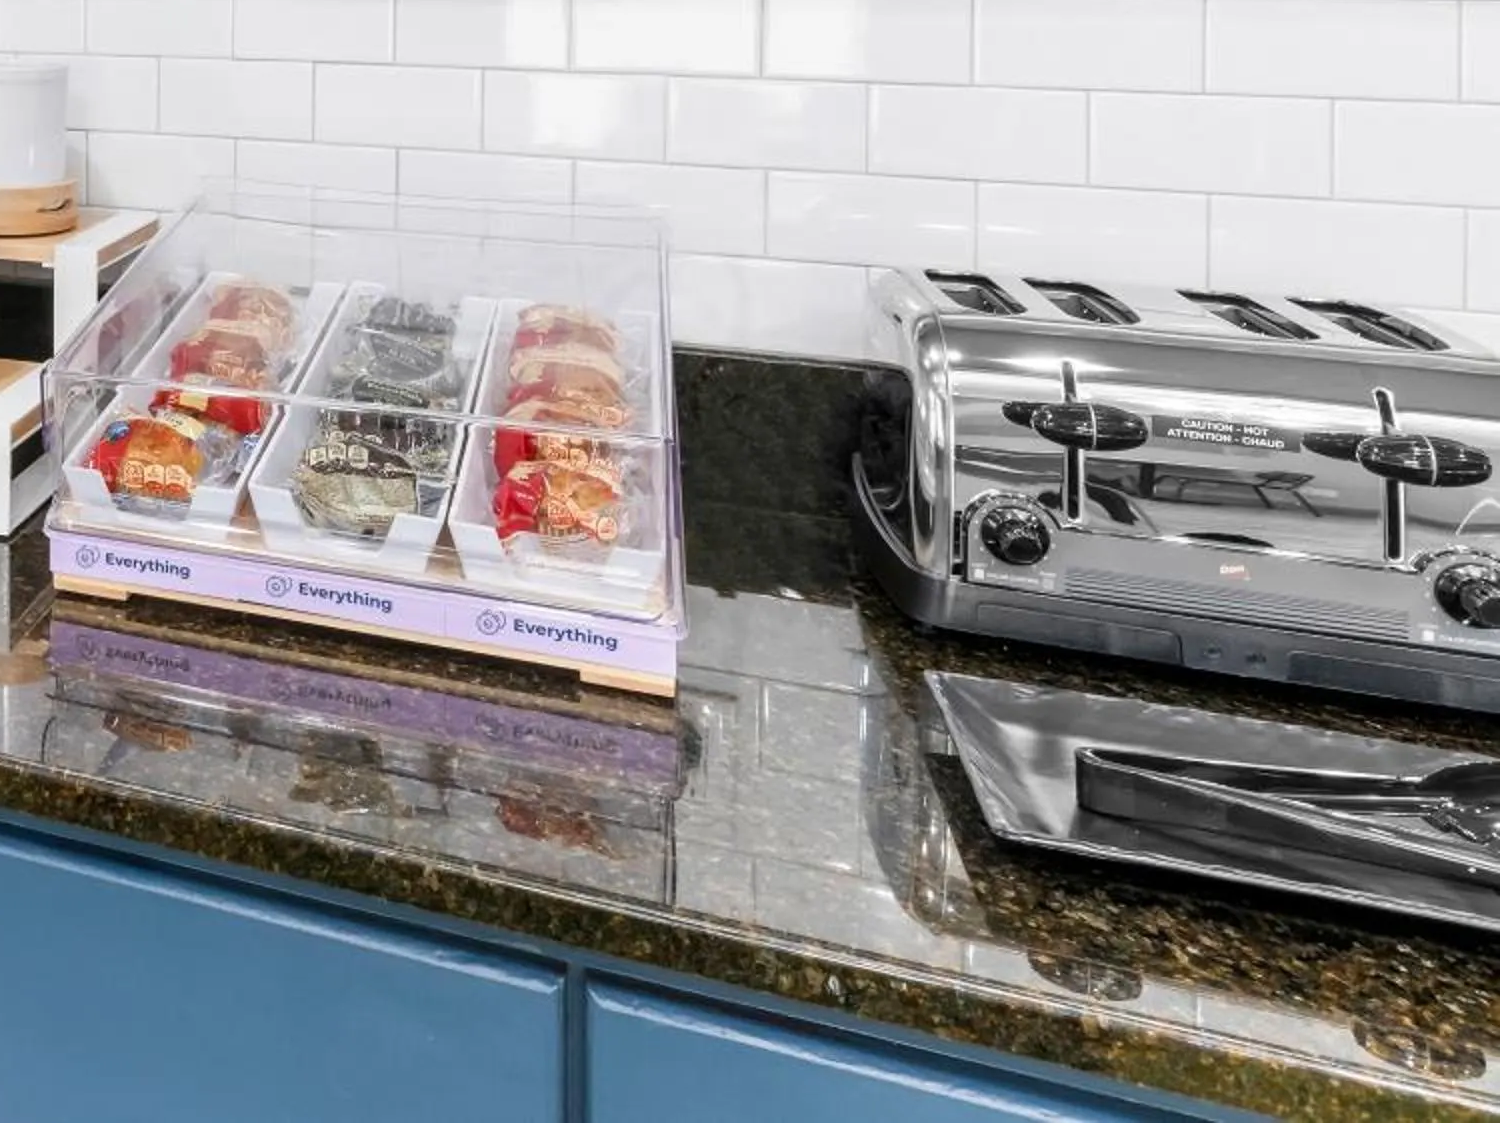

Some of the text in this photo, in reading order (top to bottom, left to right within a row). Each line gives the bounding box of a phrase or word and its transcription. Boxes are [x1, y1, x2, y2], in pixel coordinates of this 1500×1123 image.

[1167, 428, 1232, 443] ATTENTION
[1242, 436, 1285, 449] CHAUD
[1181, 419, 1233, 433] CAUTION
[1244, 426, 1269, 437] HOT
[105, 551, 191, 579] Everything
[298, 582, 393, 613] Everything
[513, 618, 618, 651] Everything
